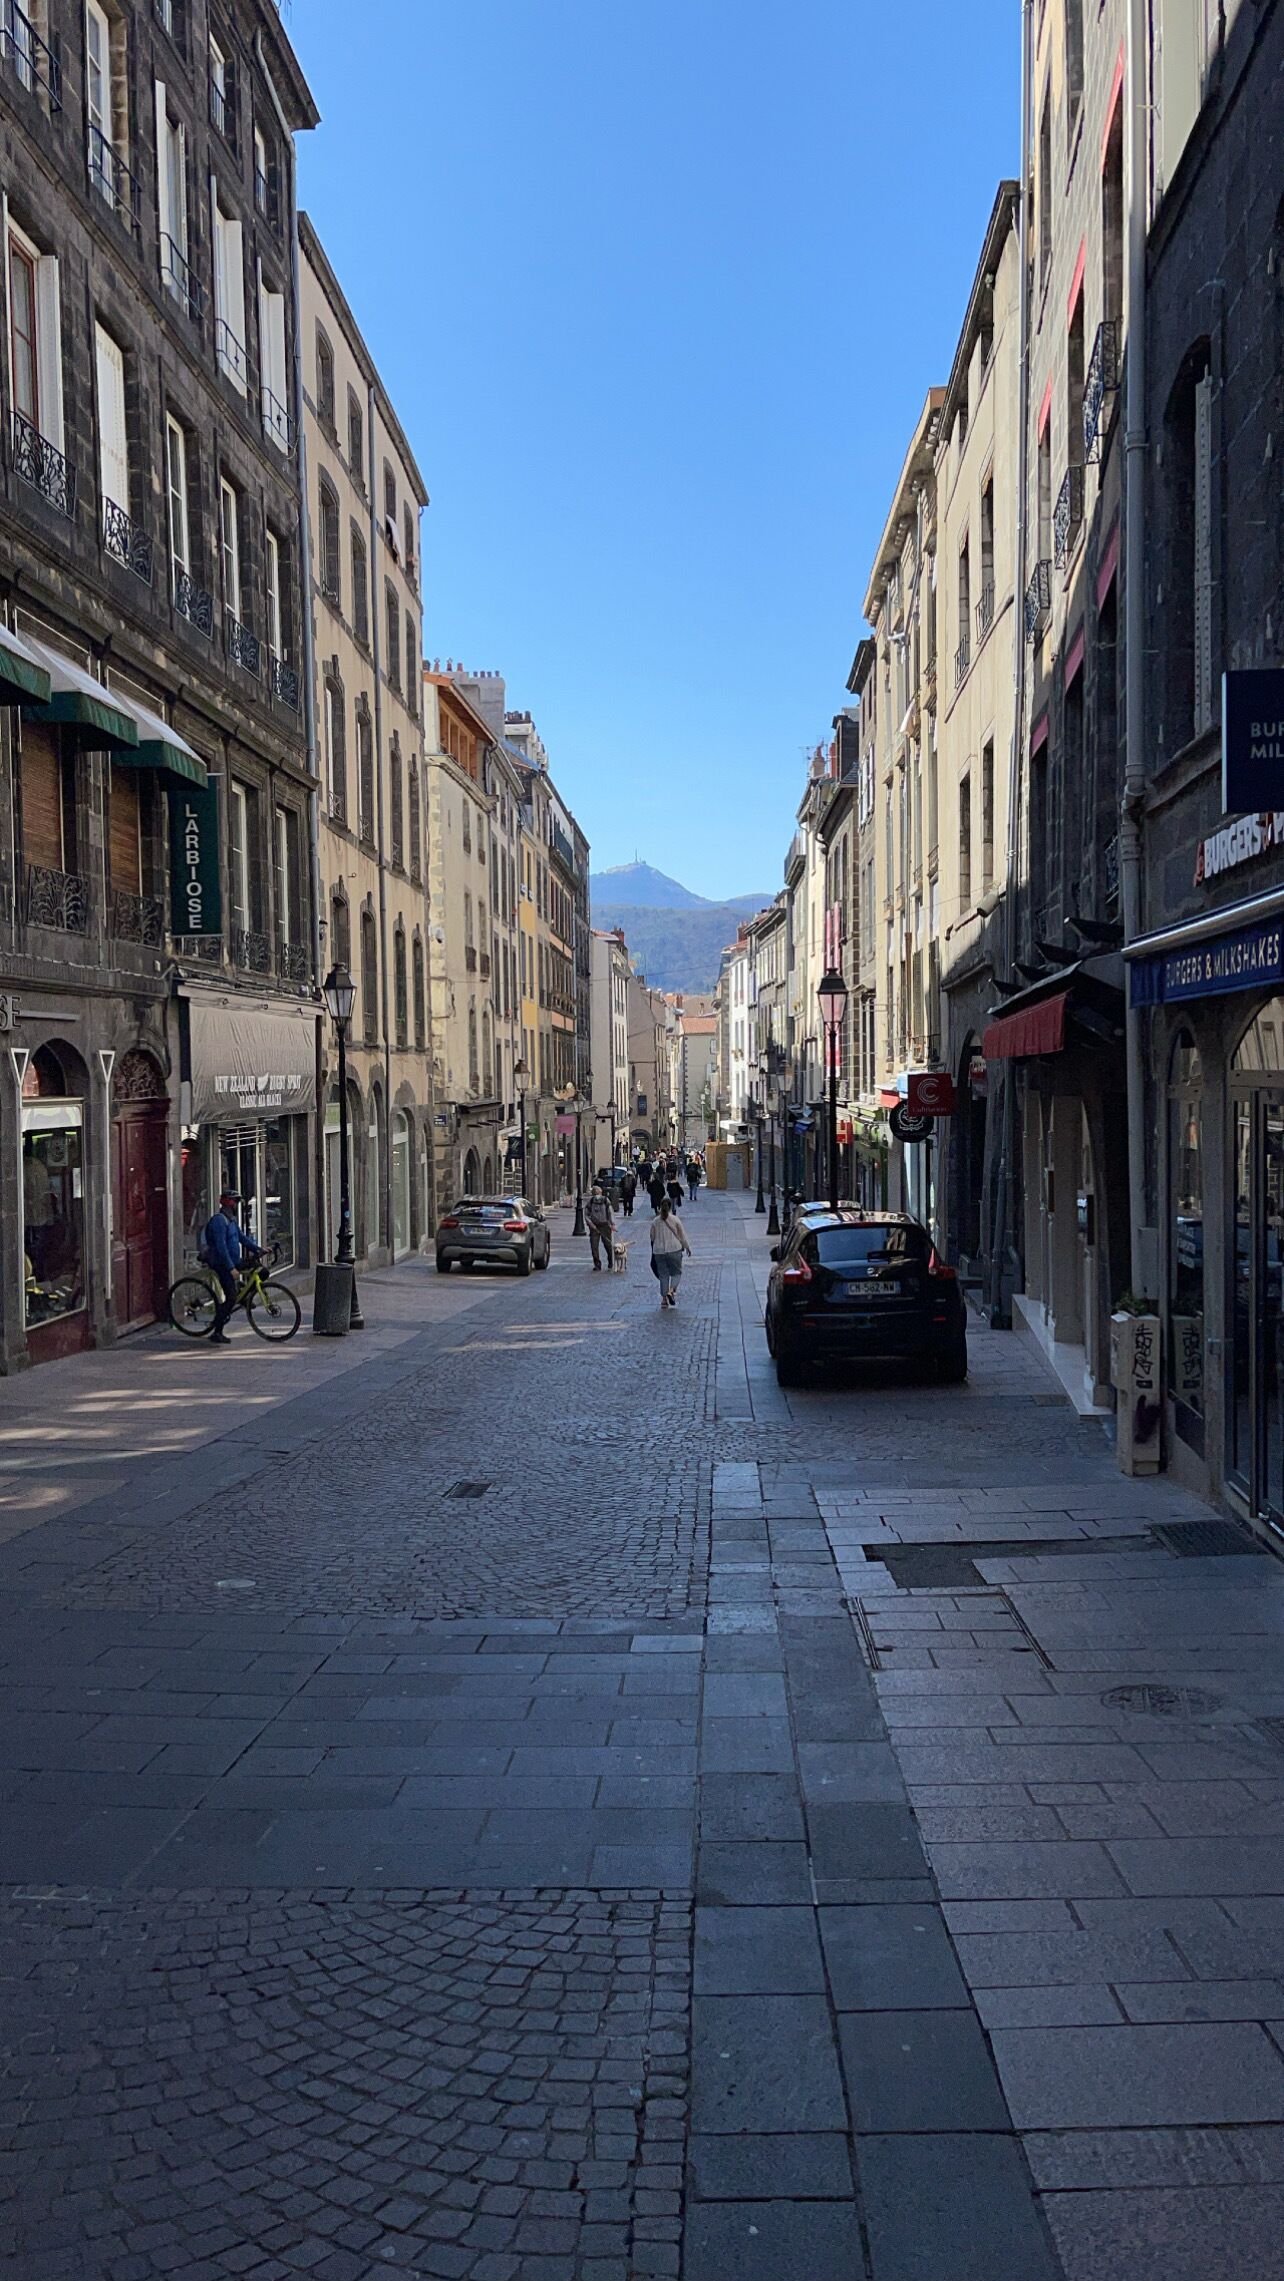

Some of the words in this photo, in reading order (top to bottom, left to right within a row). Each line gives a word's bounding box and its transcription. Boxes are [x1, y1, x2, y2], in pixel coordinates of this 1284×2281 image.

[185, 803, 202, 929] LARBIOSE
[1204, 813, 1261, 878] BURGERS
[1166, 955, 1202, 989] BURGERS
[1205, 953, 1212, 980] &
[1214, 933, 1279, 977] MILKSHAKES
[215, 1075, 229, 1093] NEW
[230, 1075, 256, 1092] ZEALAND
